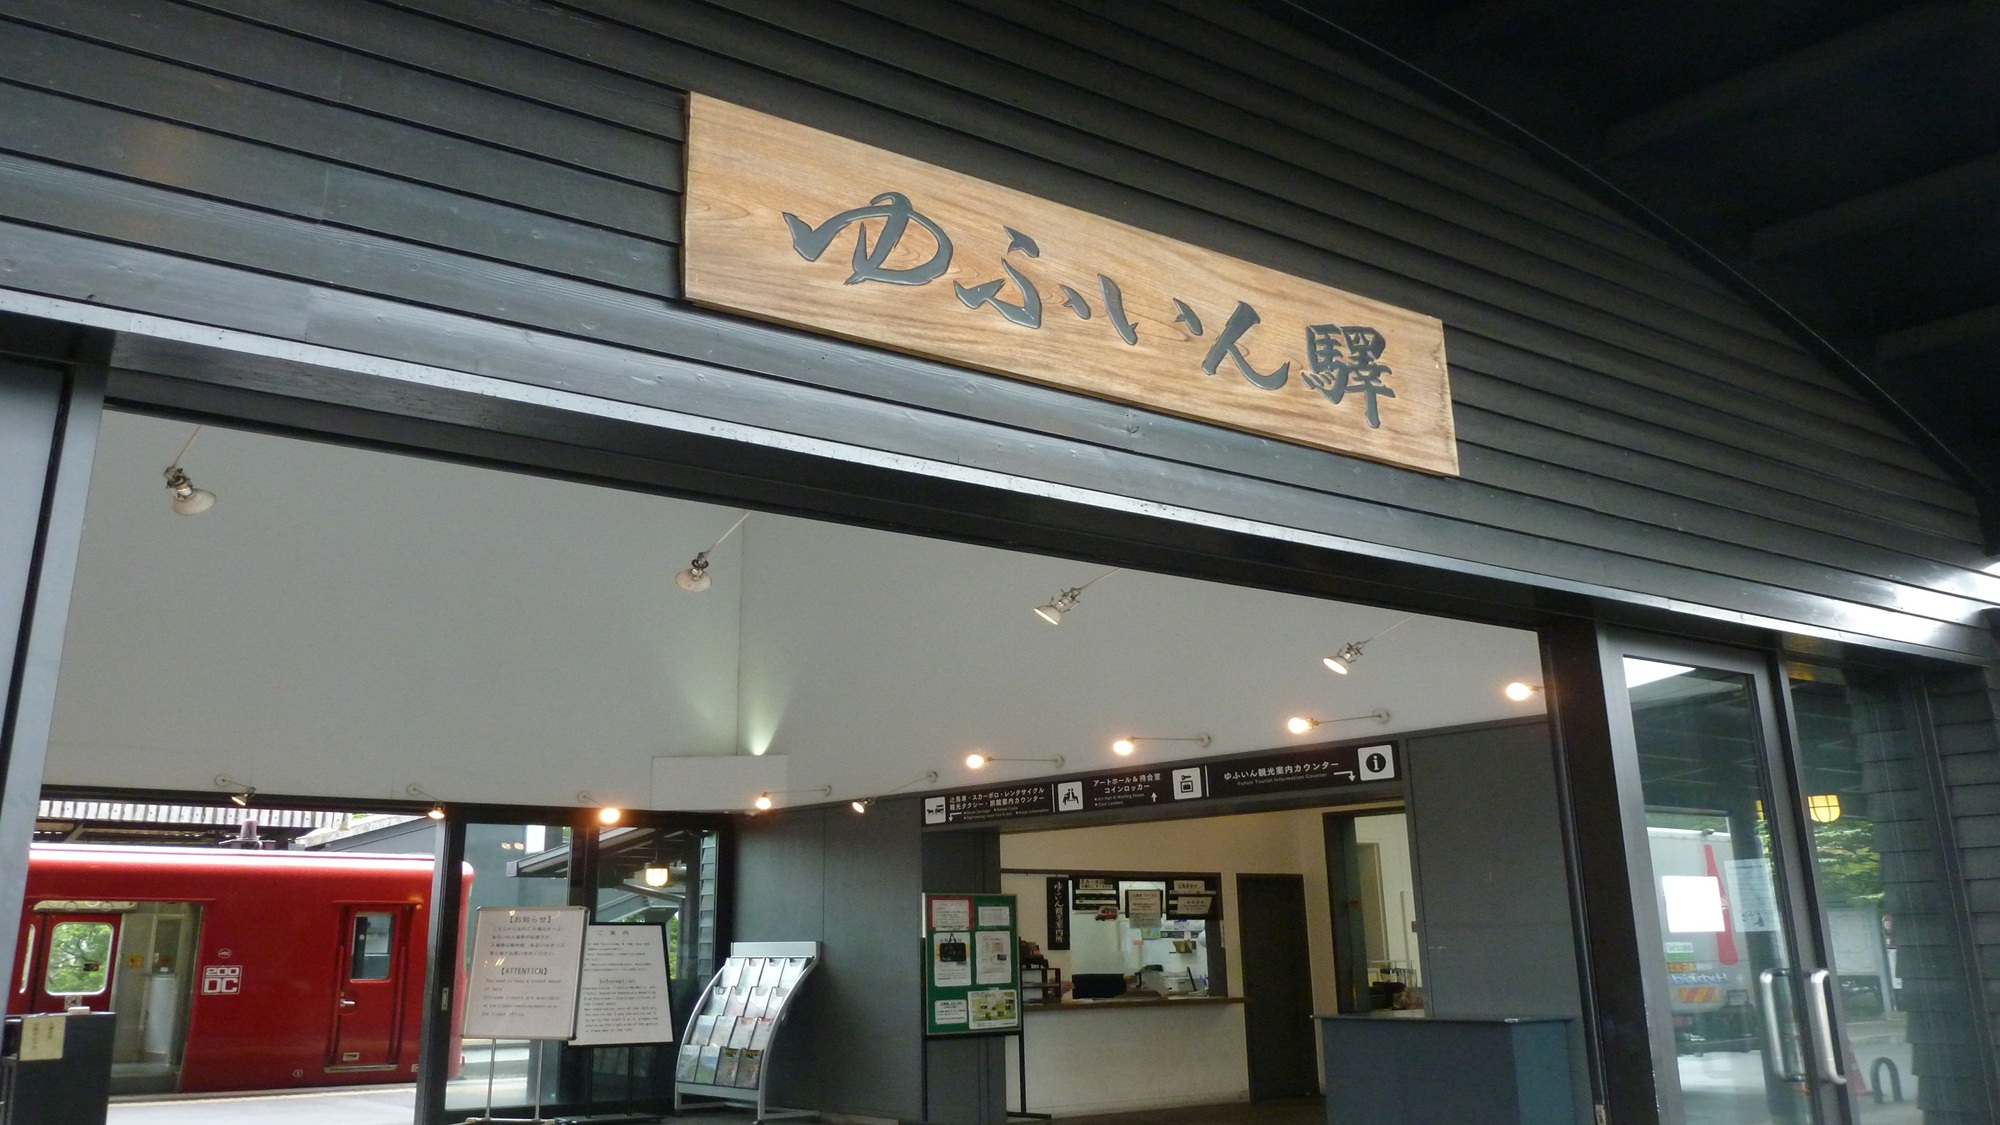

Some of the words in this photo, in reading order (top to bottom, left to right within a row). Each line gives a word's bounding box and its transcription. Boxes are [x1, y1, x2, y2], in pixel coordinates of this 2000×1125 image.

[1223, 761, 1339, 781] ゆふいん観光案内カウンター
[1104, 783, 1150, 794] コインロッカー
[205, 967, 240, 976] 200
[204, 977, 239, 994] DC
